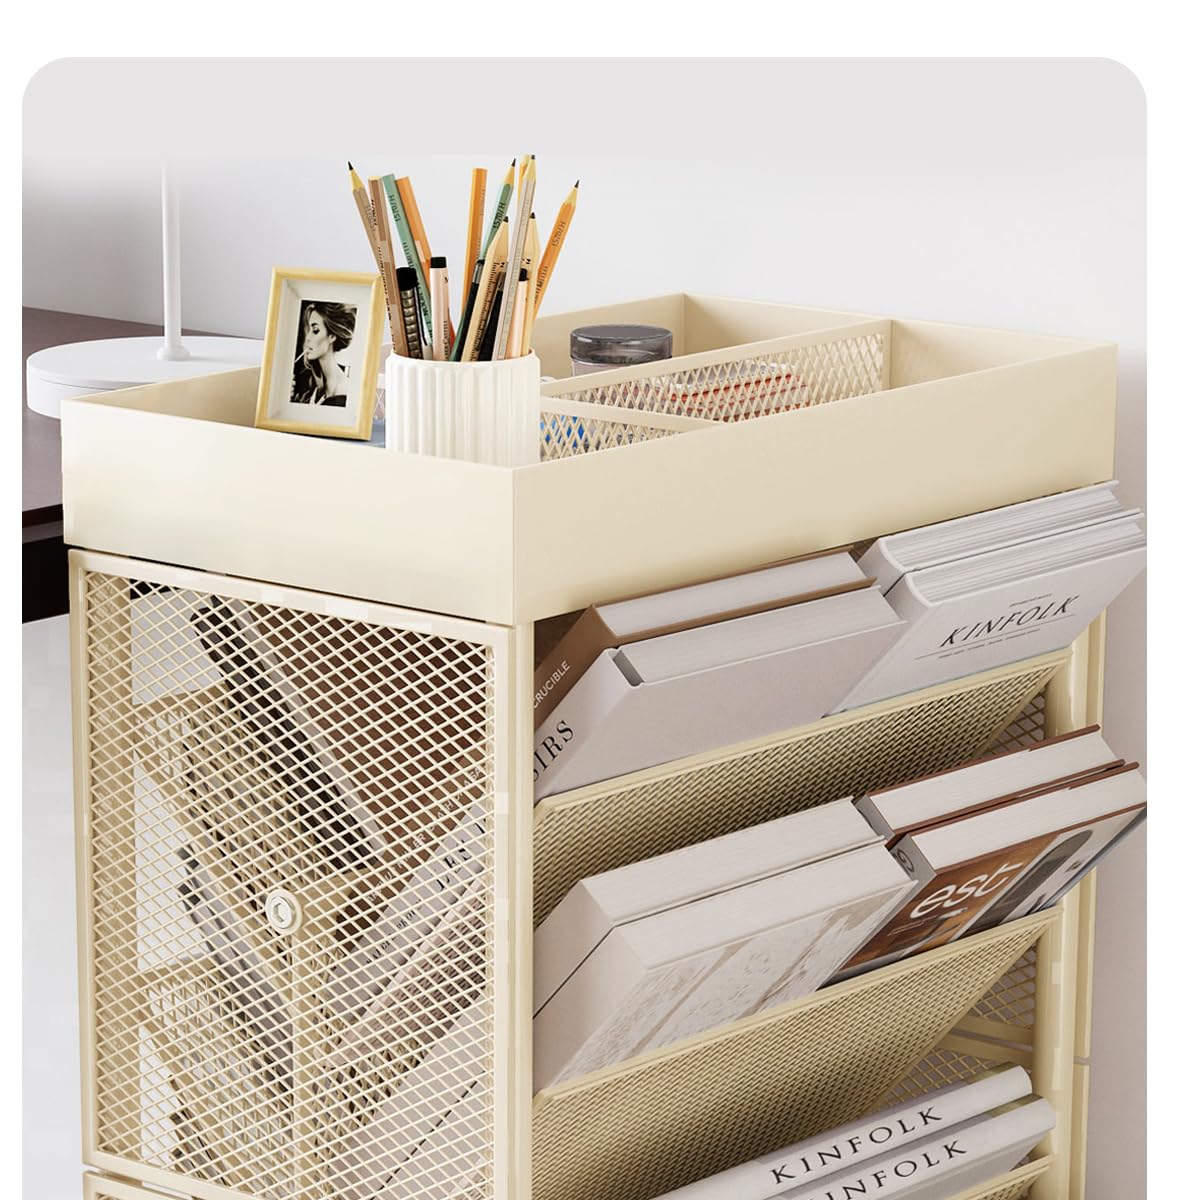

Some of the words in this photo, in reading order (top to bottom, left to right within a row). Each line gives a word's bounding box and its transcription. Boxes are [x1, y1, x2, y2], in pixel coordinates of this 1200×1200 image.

[940, 595, 1079, 649] KINFOLK
[909, 860, 1026, 919] est
[771, 1106, 943, 1185] KINFOLK
